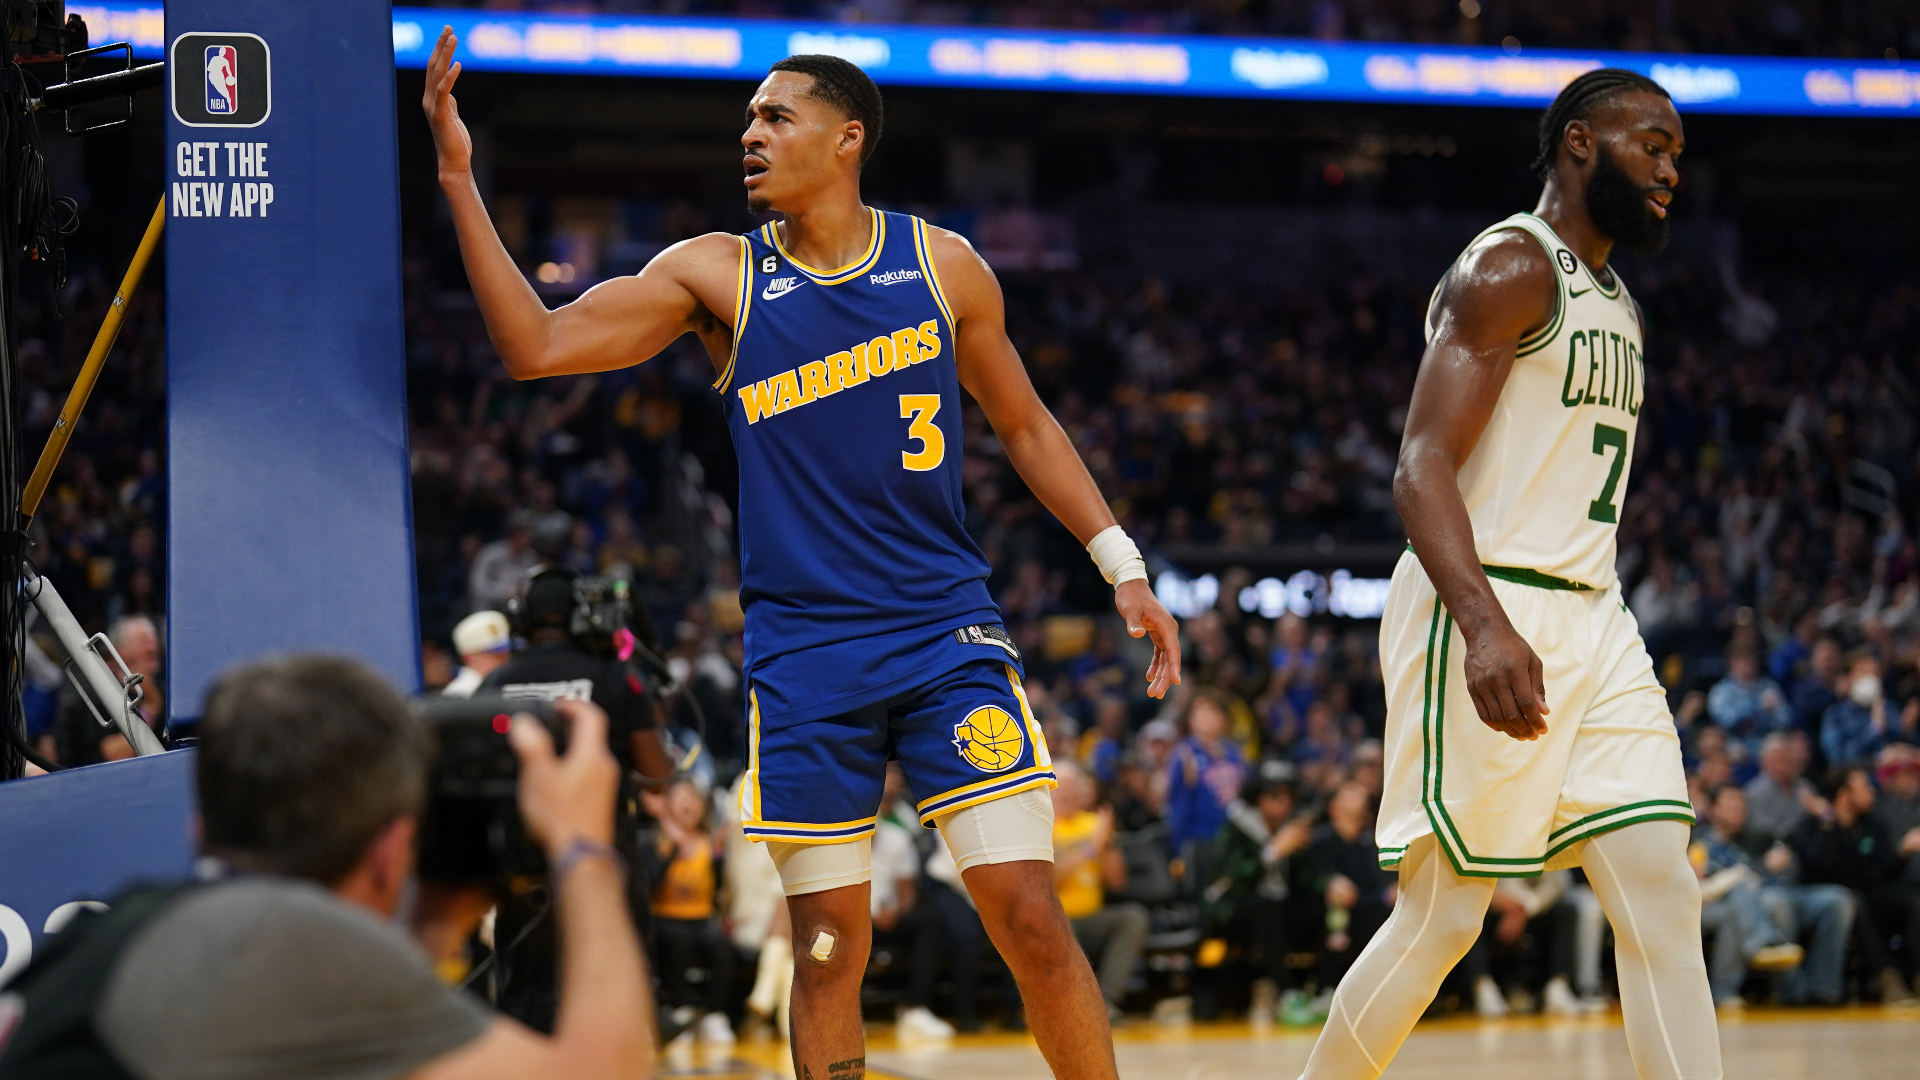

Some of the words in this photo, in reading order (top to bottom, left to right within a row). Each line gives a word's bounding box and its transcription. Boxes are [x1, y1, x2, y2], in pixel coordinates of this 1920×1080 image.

[210, 98, 226, 110] NBA
[176, 141, 220, 177] GET
[224, 142, 269, 177] THE
[172, 182, 224, 217] NEW
[229, 182, 274, 217] APP
[762, 255, 777, 273] 6
[1559, 251, 1575, 272] 6
[768, 276, 797, 292] NIKE
[870, 269, 922, 285] Rakuten
[737, 319, 941, 425] WARRIORS
[899, 393, 945, 471] 3
[1588, 422, 1628, 524] 7
